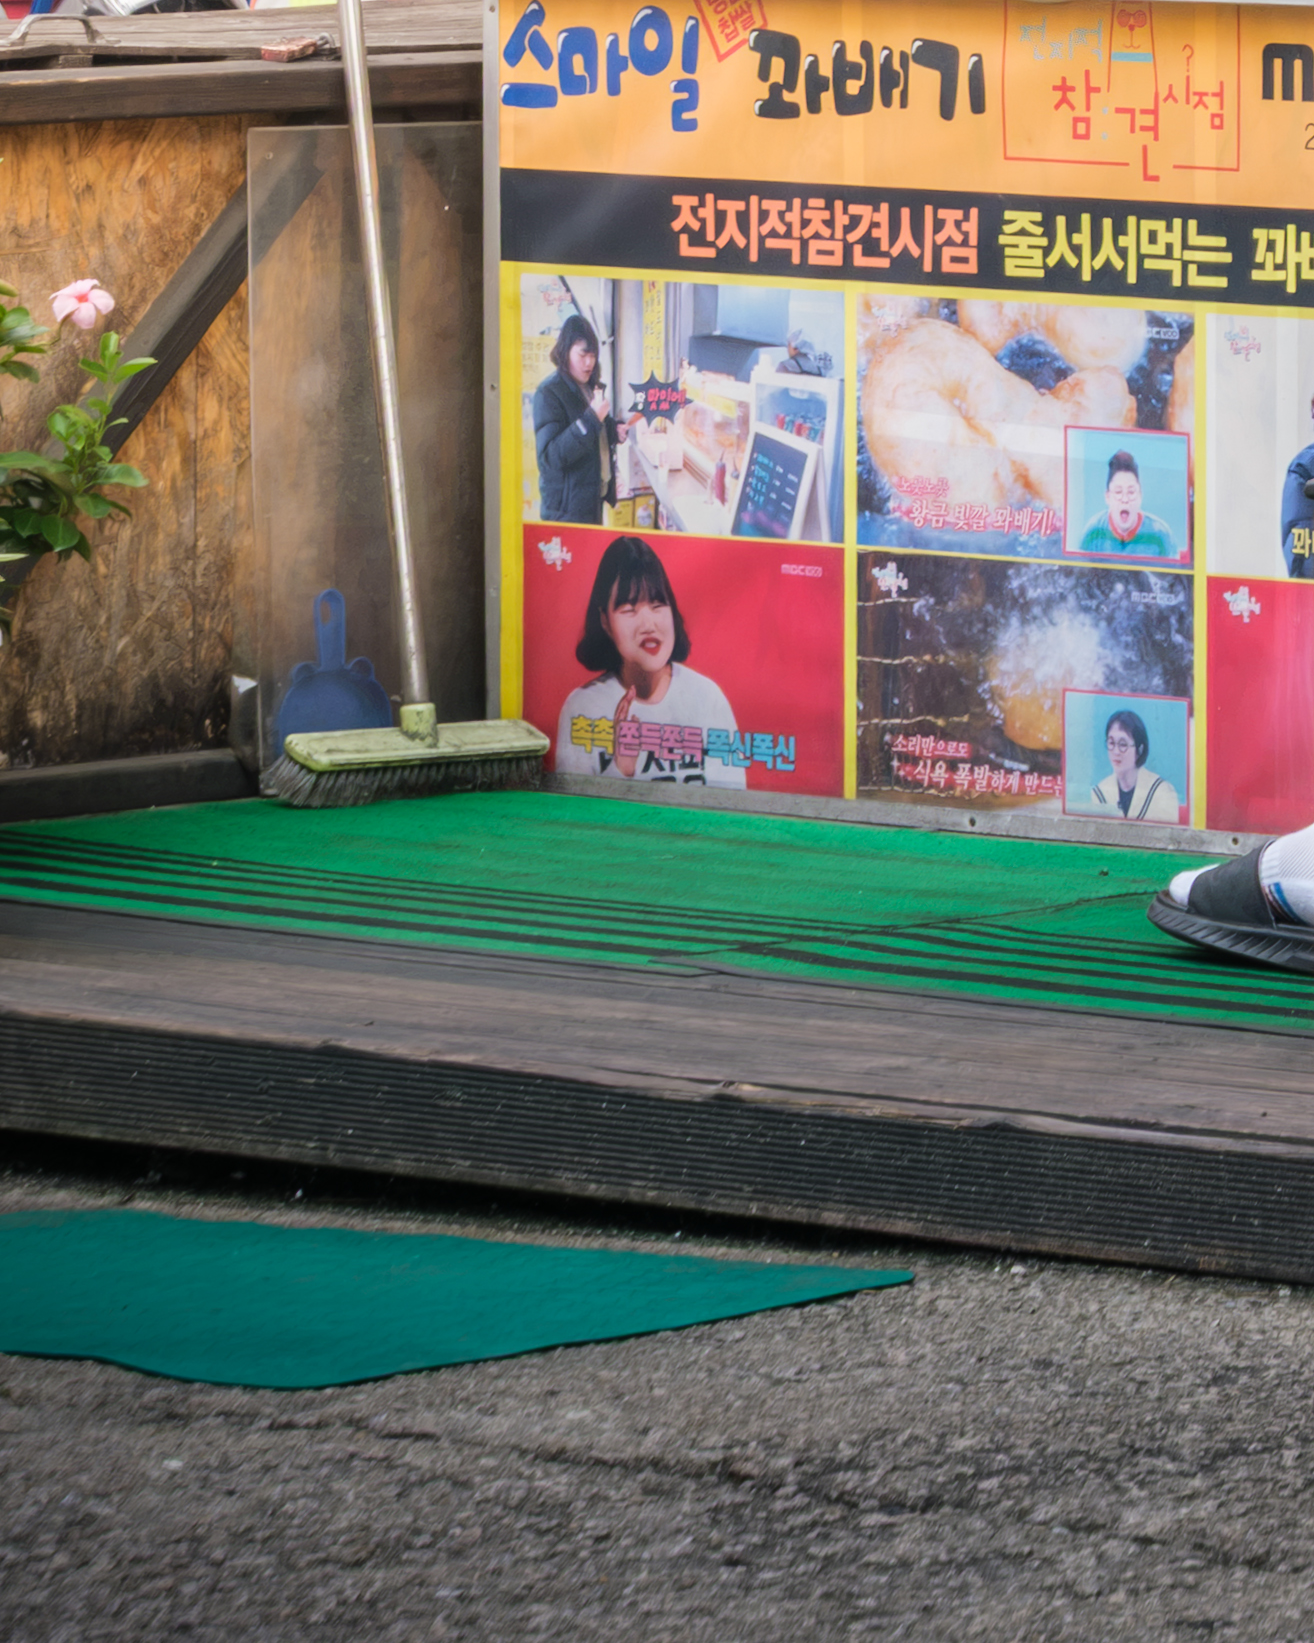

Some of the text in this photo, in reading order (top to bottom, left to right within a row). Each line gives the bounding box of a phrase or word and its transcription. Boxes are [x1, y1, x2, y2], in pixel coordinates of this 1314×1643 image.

[1019, 15, 1103, 63] 전지적
[670, 192, 979, 276] 전지적참견시점
[998, 209, 1233, 289] 줄서서먹는
[909, 498, 1055, 538] 황금 빛깔 꽈배기!
[618, 718, 704, 763] 쫀득쫀득
[706, 726, 796, 773] 폭신폭신
[892, 734, 969, 759] 소리만으로도
[913, 759, 949, 788] 식욕
[952, 762, 1020, 795] 폭발하게
